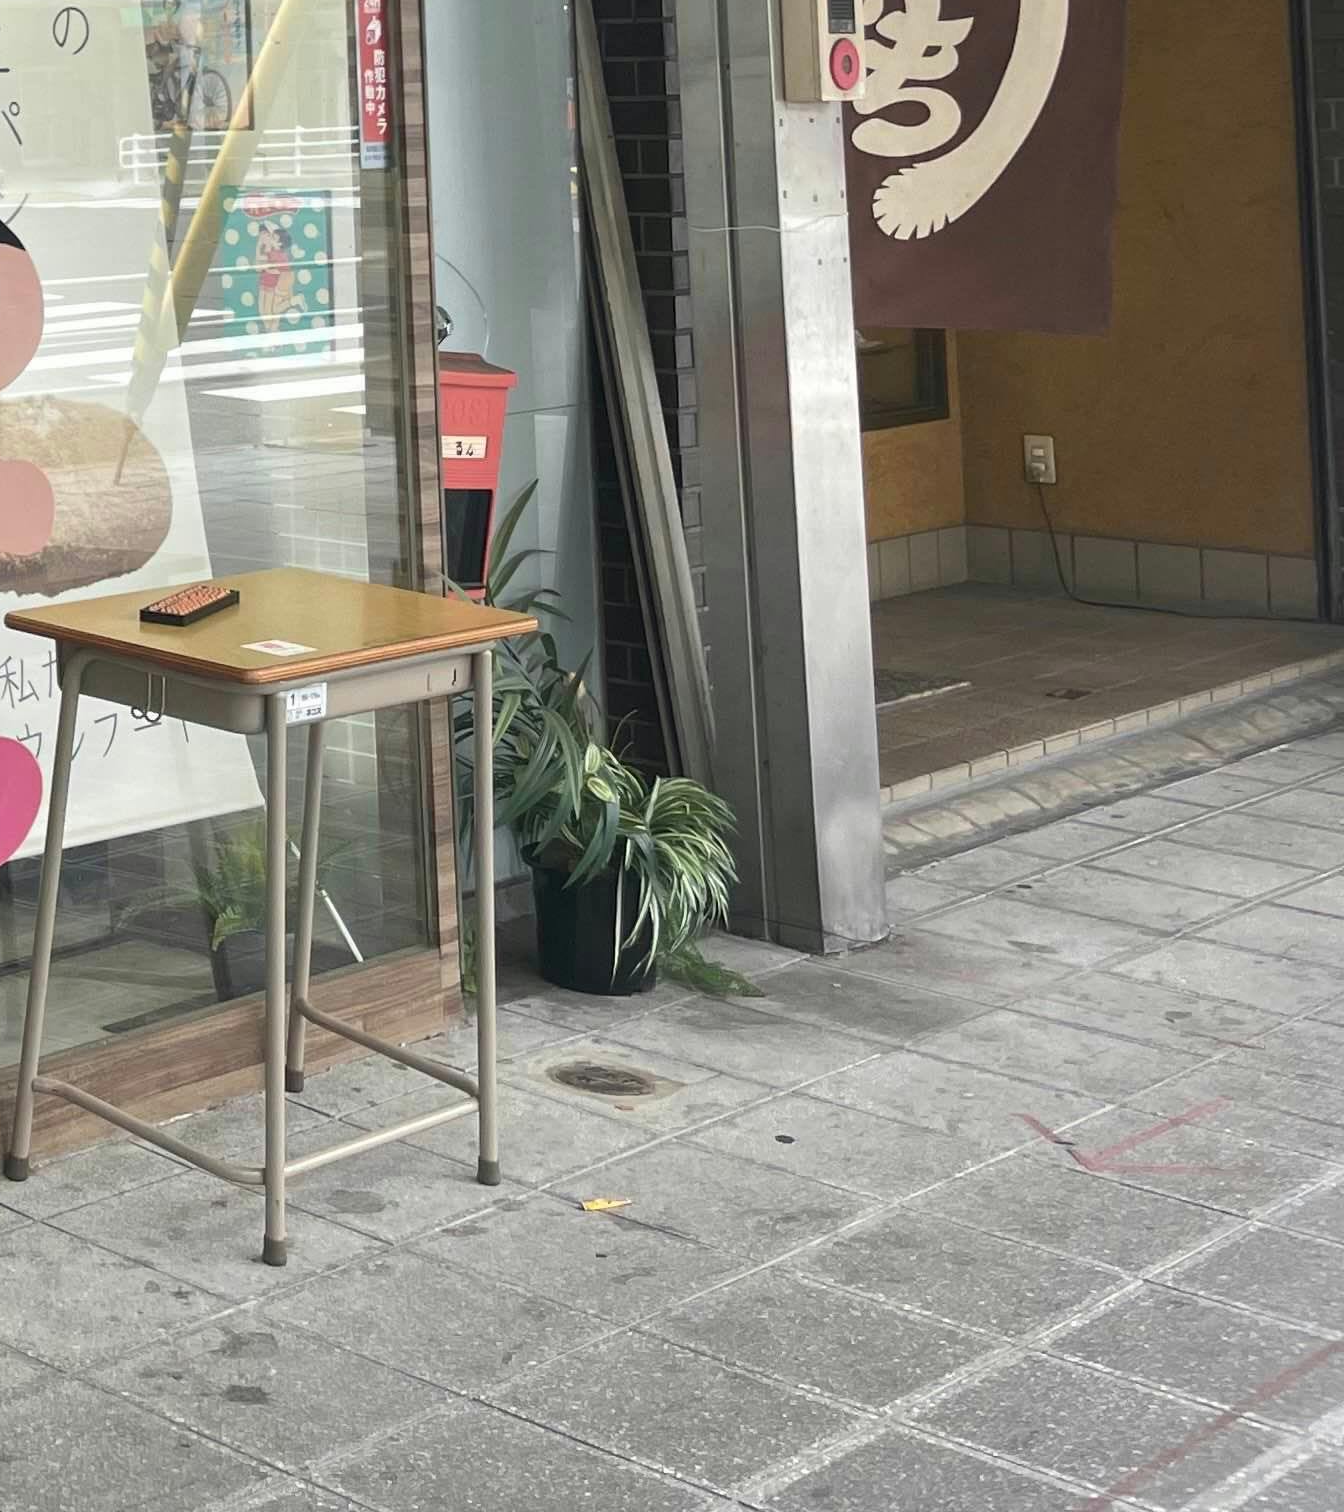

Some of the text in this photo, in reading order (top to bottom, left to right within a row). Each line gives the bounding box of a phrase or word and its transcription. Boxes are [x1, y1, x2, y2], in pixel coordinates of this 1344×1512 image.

[373, 49, 388, 135] 防犯カメラ
